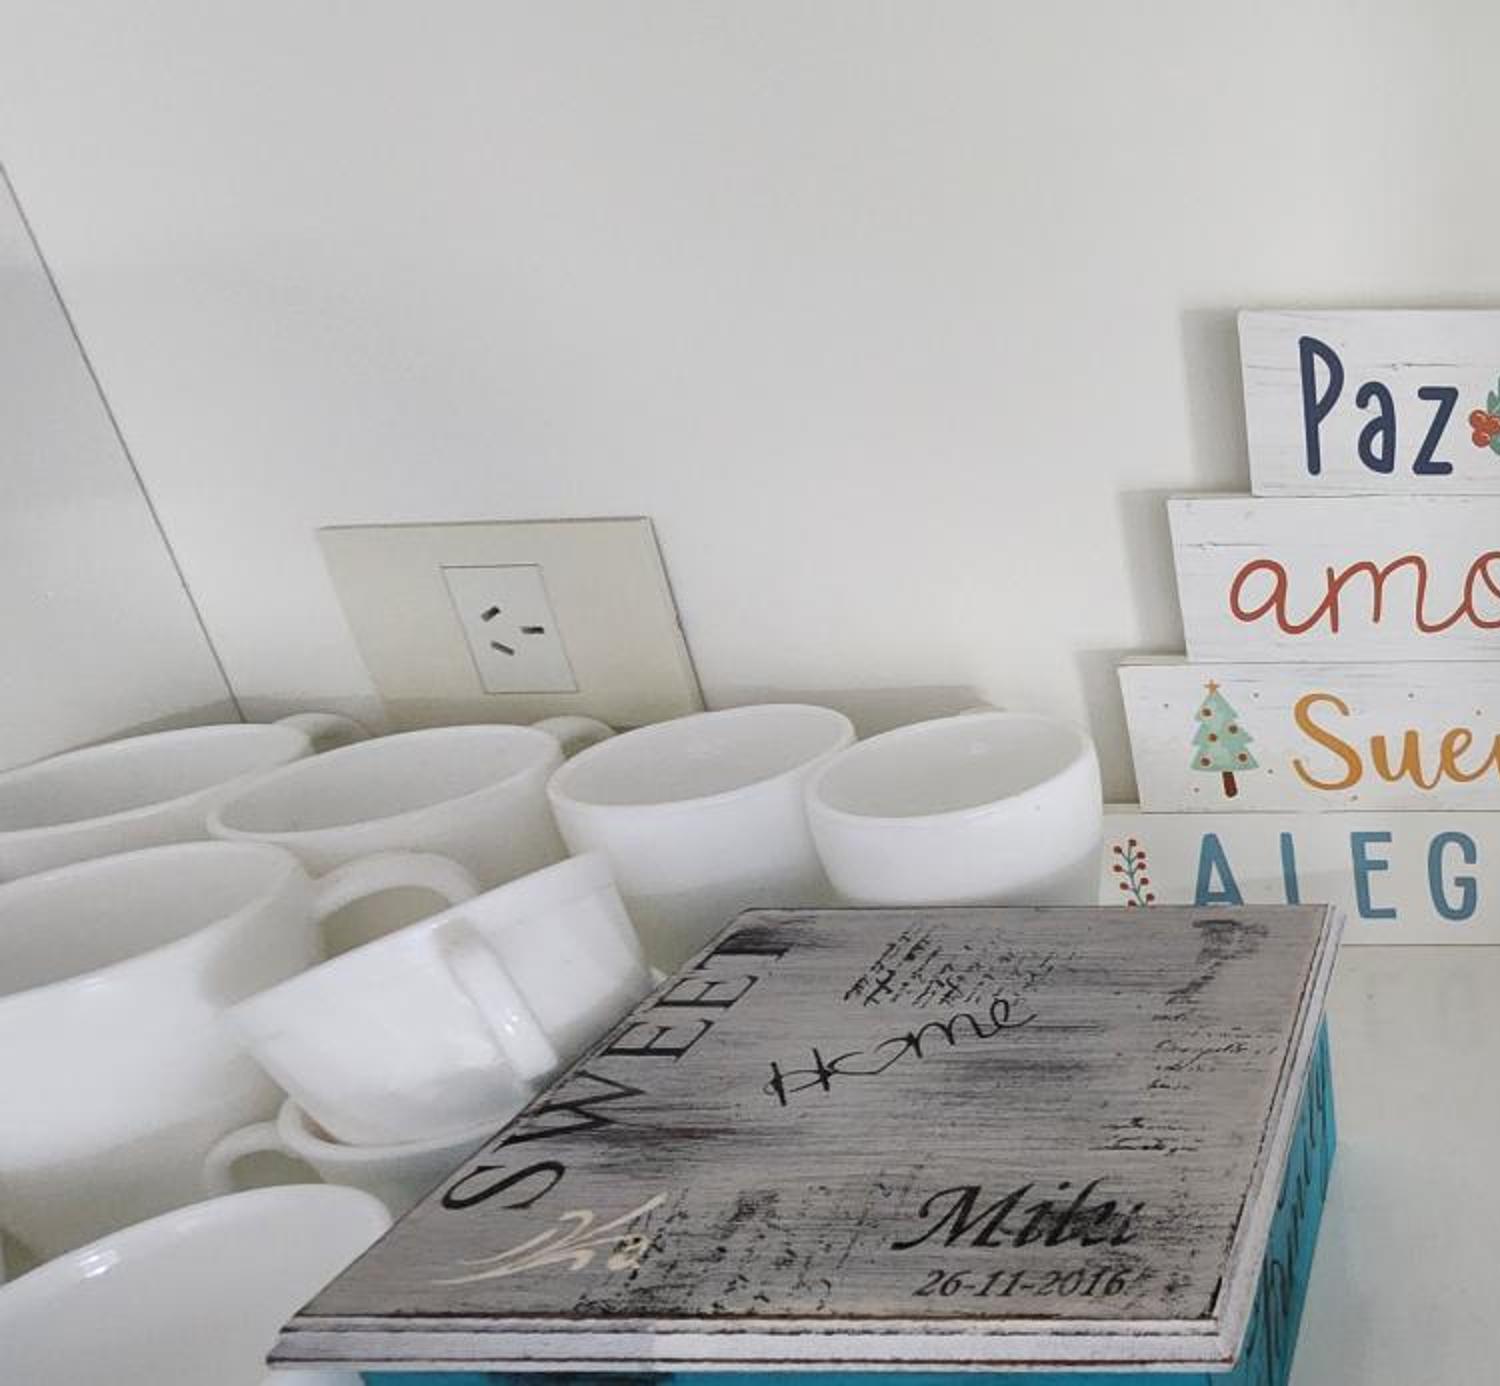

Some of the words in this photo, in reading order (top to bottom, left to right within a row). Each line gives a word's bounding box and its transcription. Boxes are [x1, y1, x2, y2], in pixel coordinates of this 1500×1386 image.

[1299, 336, 1459, 476] Paz
[442, 928, 790, 1210] SWEET
[763, 998, 1038, 1107] Home
[912, 1265, 1132, 1298] 26-11-2016
